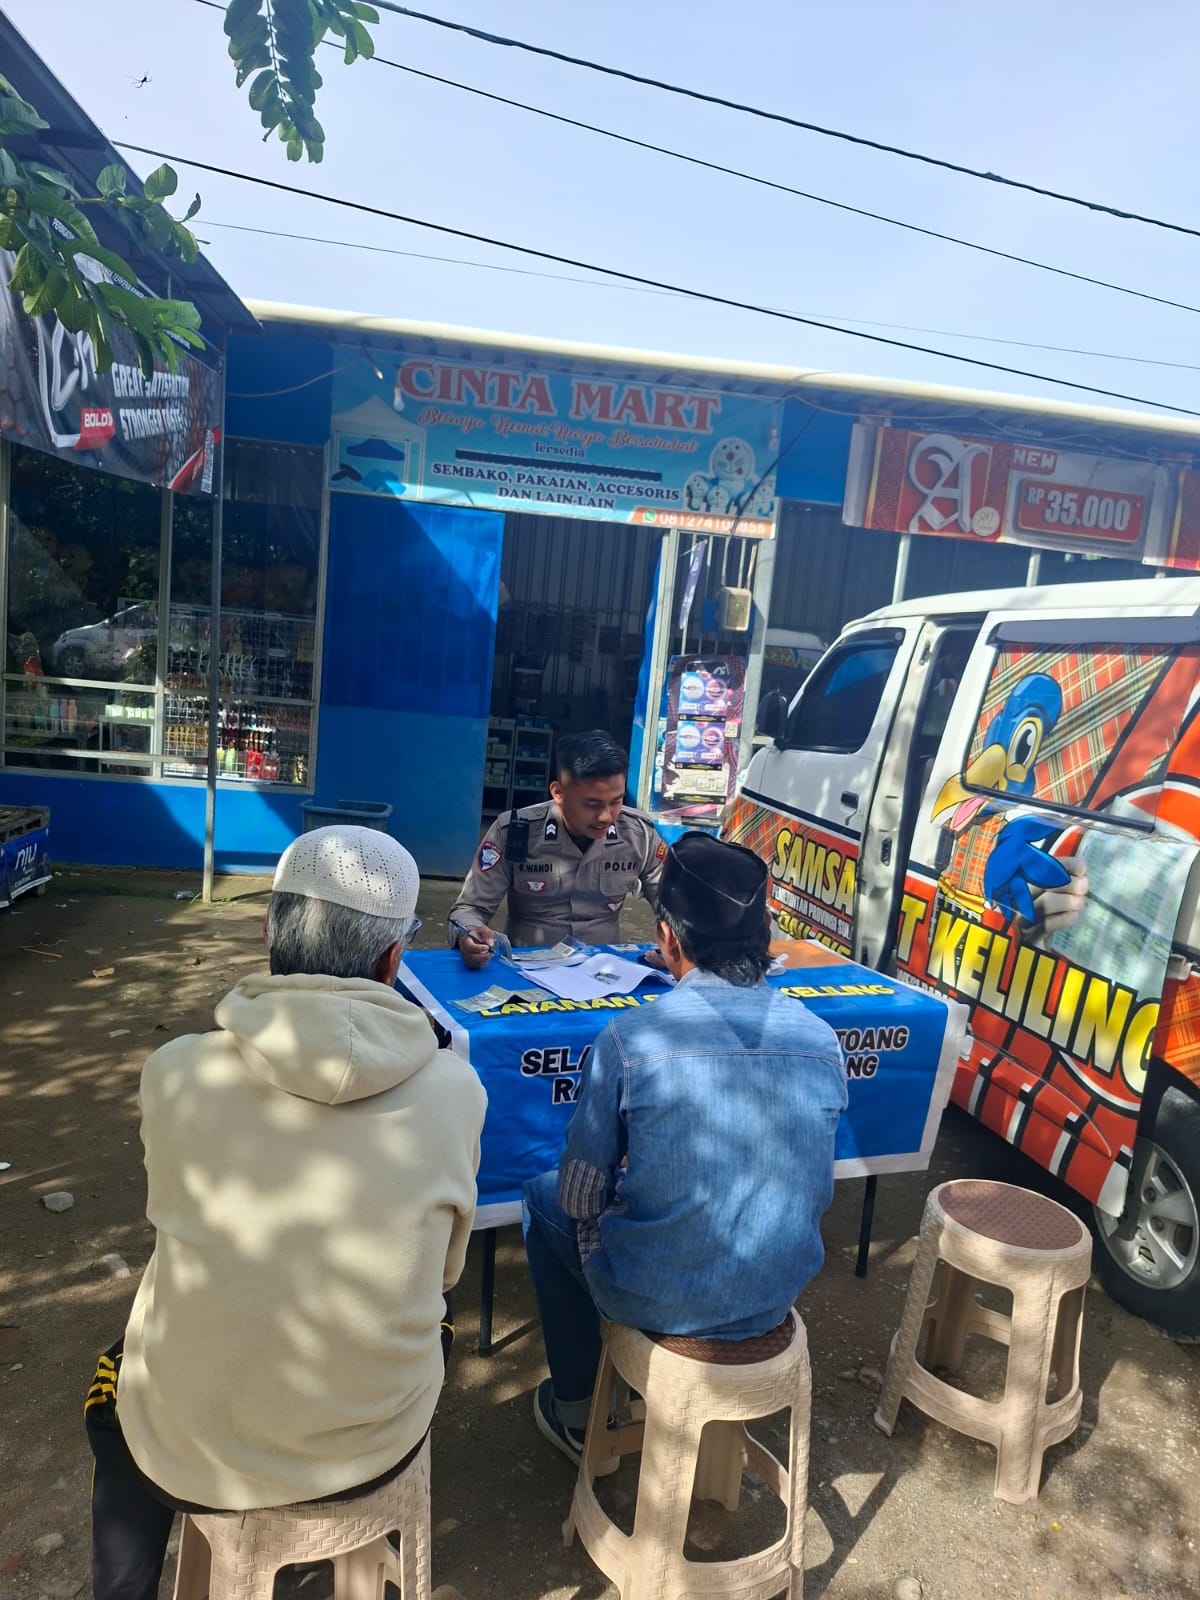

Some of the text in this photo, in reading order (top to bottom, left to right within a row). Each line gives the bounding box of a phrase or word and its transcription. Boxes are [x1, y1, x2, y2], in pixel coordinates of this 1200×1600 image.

[111, 362, 144, 398] GREAT
[399, 360, 721, 432] CINTA MART
[84, 412, 109, 428] BOLD
[119, 408, 164, 441] STRONGER
[490, 416, 549, 436] Hemat
[550, 422, 603, 448] Harga
[608, 429, 698, 452] Bersahabat
[535, 442, 585, 458] Tersedia
[1014, 448, 1055, 470] NEW
[432, 463, 681, 501] SEMBAKO, PAKAIAN, ACCESORIS
[498, 487, 615, 510] DAN LAIN-LAIN
[1028, 487, 1131, 532] RP 35.000
[605, 862, 636, 872] POLRI
[771, 828, 857, 918] SAMSA
[927, 911, 1160, 1094] KELILING
[480, 995, 641, 1017] LAYANAN
